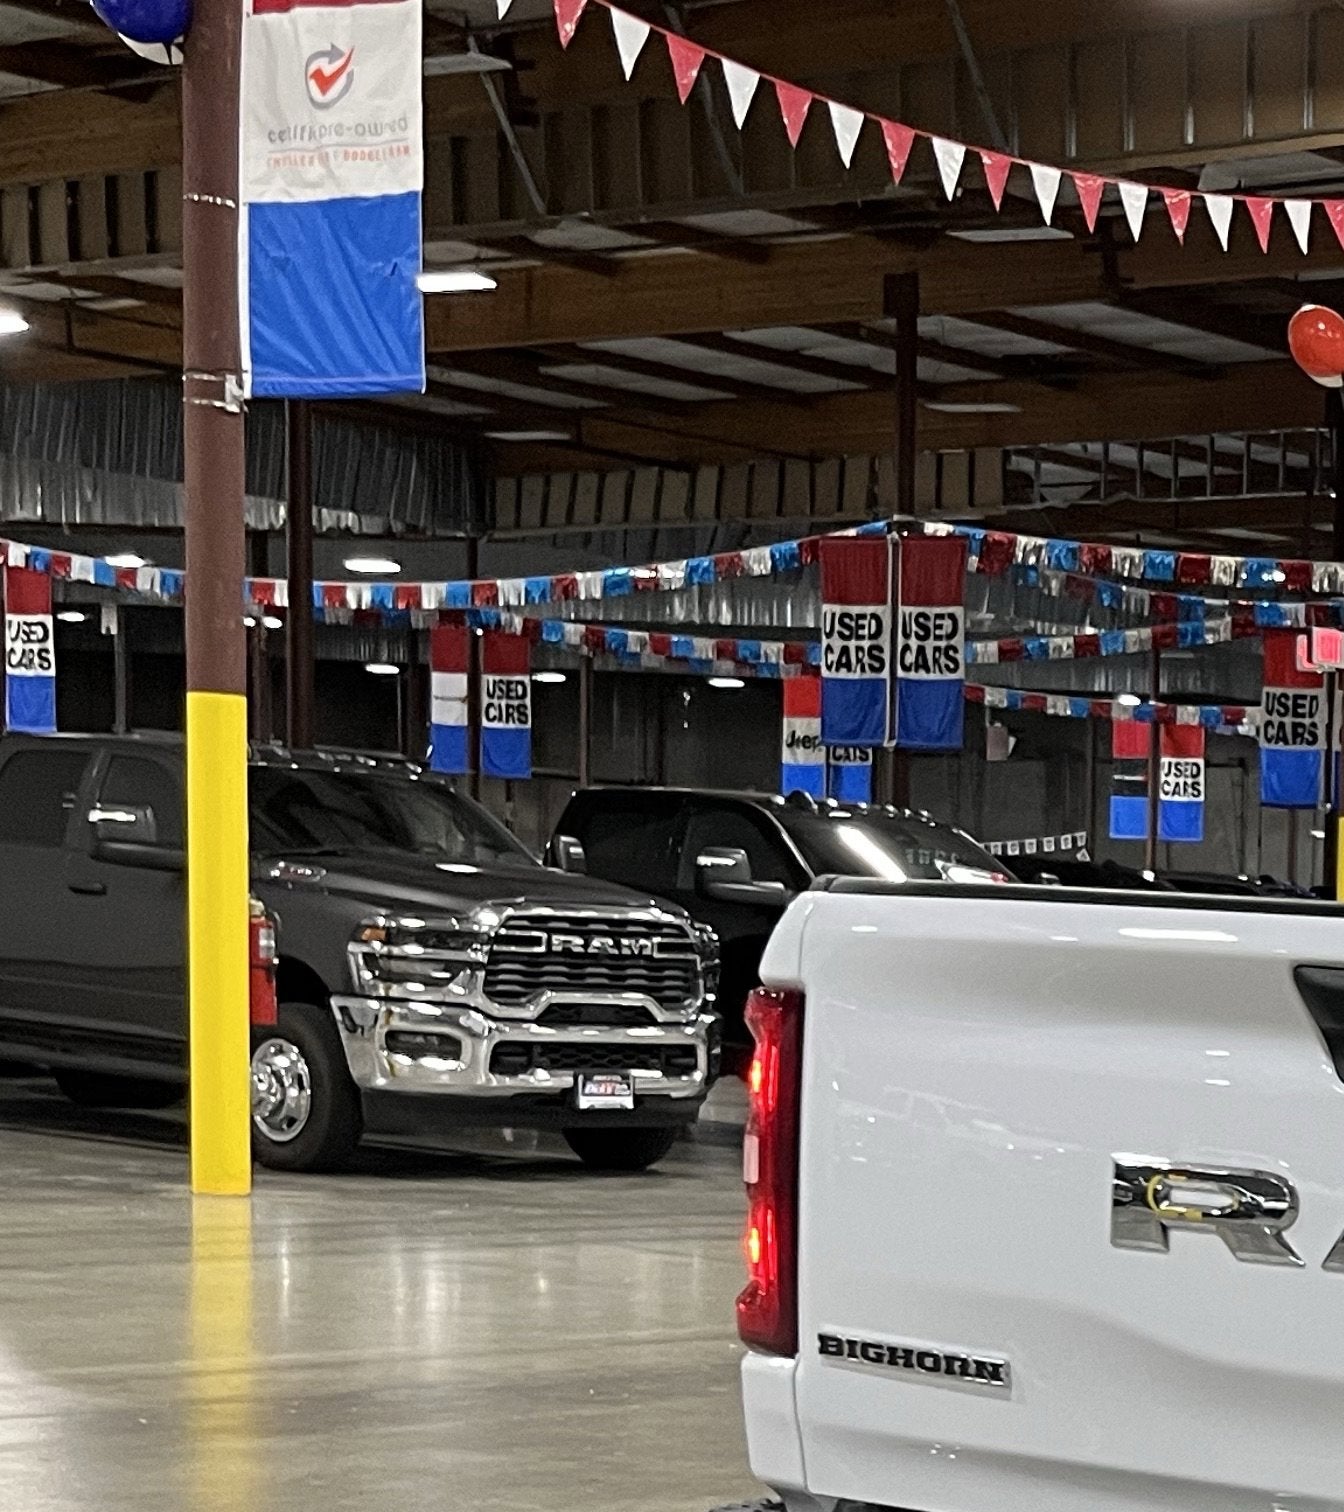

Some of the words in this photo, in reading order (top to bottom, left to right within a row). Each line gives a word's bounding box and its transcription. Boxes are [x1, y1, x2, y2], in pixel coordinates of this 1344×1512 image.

[824, 612, 883, 641] USED
[901, 611, 958, 641] USED
[824, 643, 886, 674] CARS
[900, 643, 960, 674] CARS
[486, 679, 527, 699] USED
[1265, 692, 1319, 718] USED
[1263, 720, 1319, 746] CARS
[1161, 761, 1201, 778] USED
[551, 934, 652, 954] RAM
[817, 1332, 1006, 1382] BIGHORN
